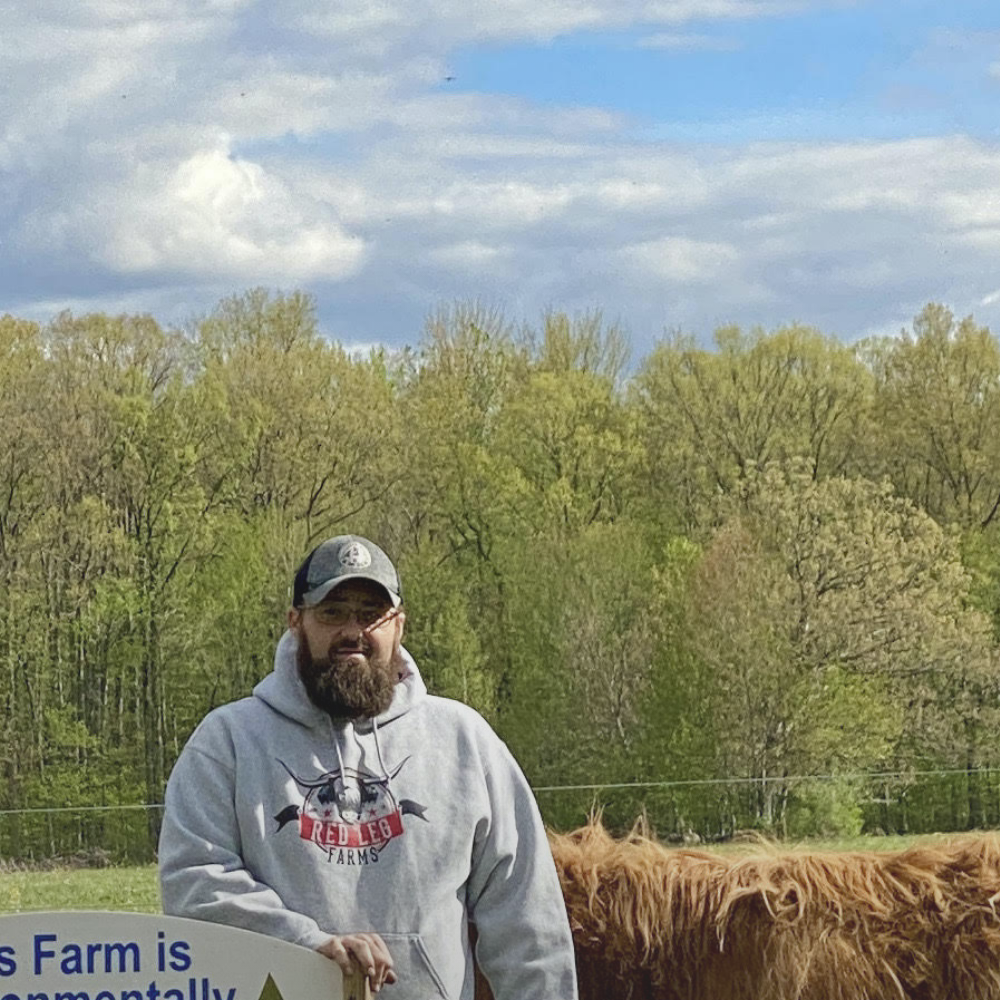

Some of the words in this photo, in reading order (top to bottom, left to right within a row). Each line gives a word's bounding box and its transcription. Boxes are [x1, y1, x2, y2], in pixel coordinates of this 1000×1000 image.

[311, 821, 348, 845] RED
[358, 819, 392, 845] LEG
[327, 846, 380, 866] FARMS
[33, 933, 141, 975] Farm
[156, 931, 192, 972] is
